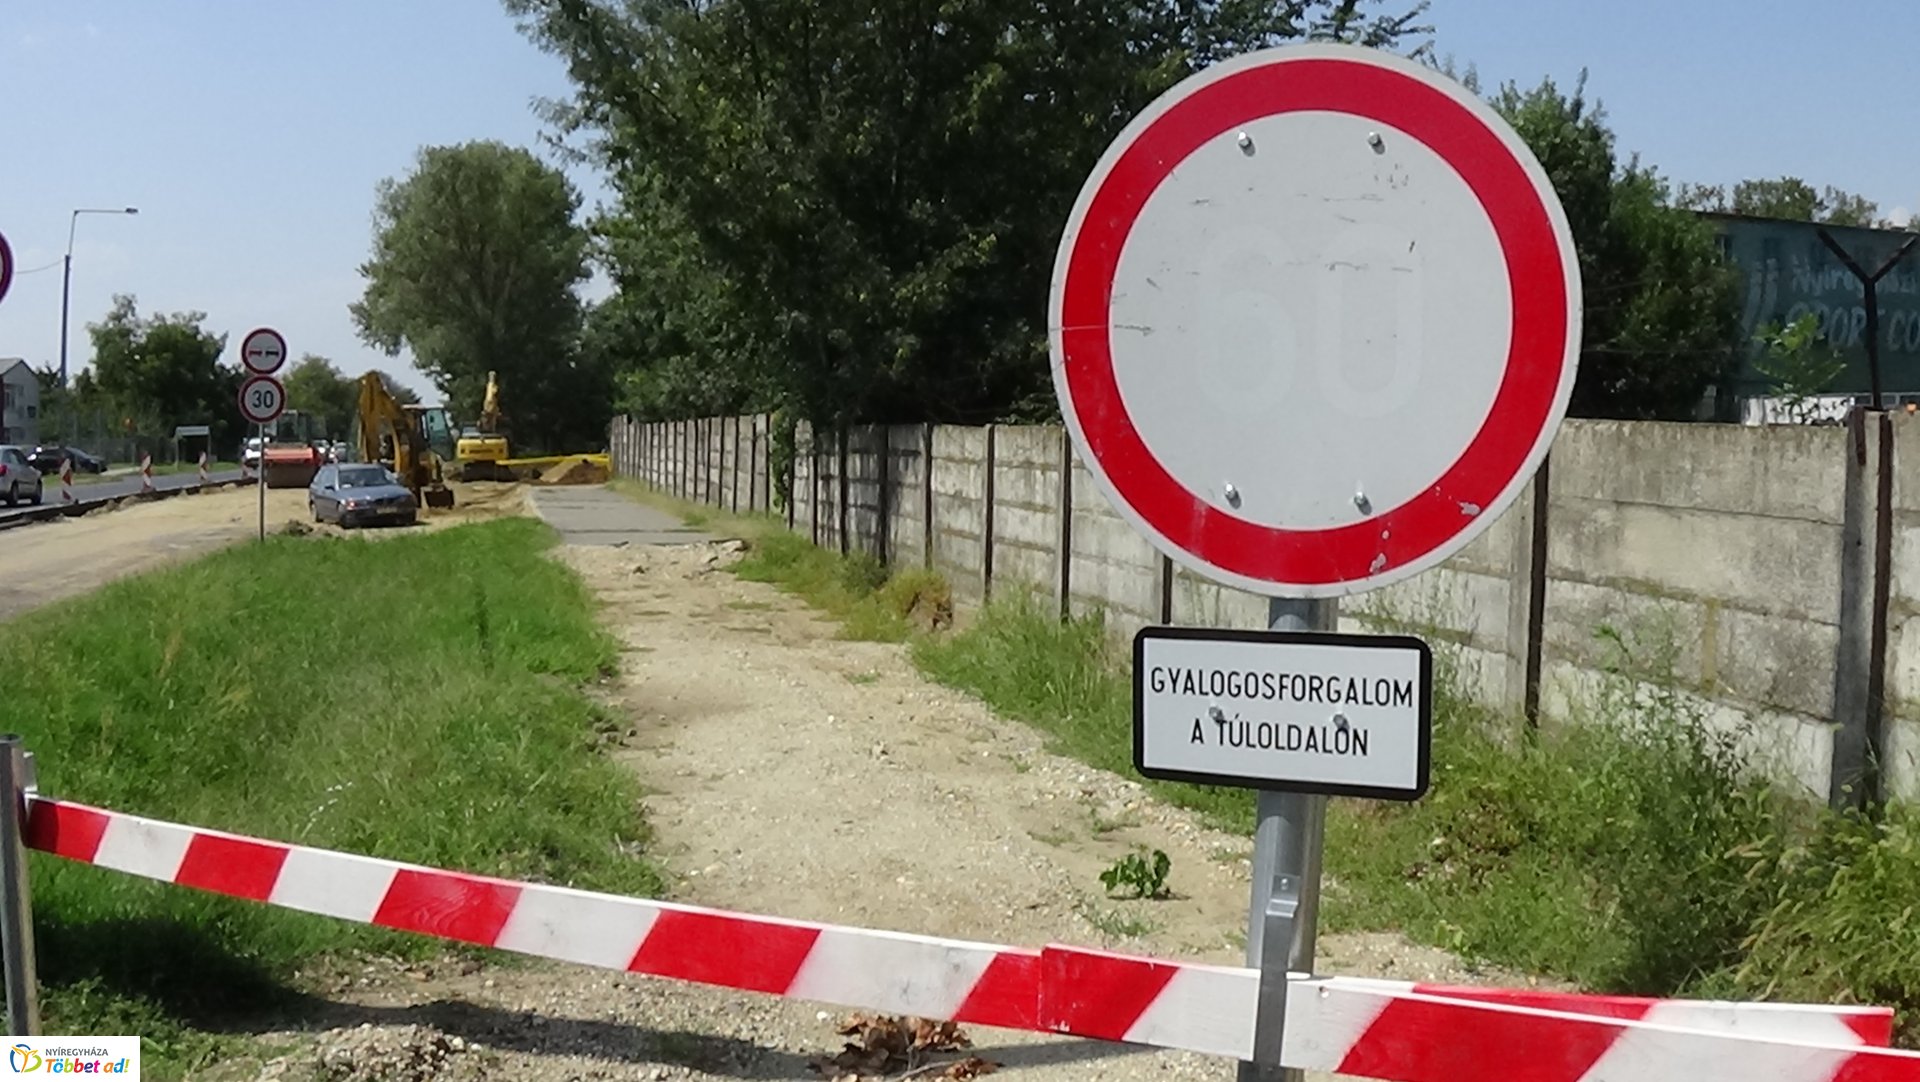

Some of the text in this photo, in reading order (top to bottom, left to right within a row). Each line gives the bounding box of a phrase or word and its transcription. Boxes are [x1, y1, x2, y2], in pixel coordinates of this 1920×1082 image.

[252, 390, 274, 408] 30
[1150, 667, 1413, 708] GYALOGOSFORGALOM
[1190, 714, 1369, 757] A TÚLOLDALON
